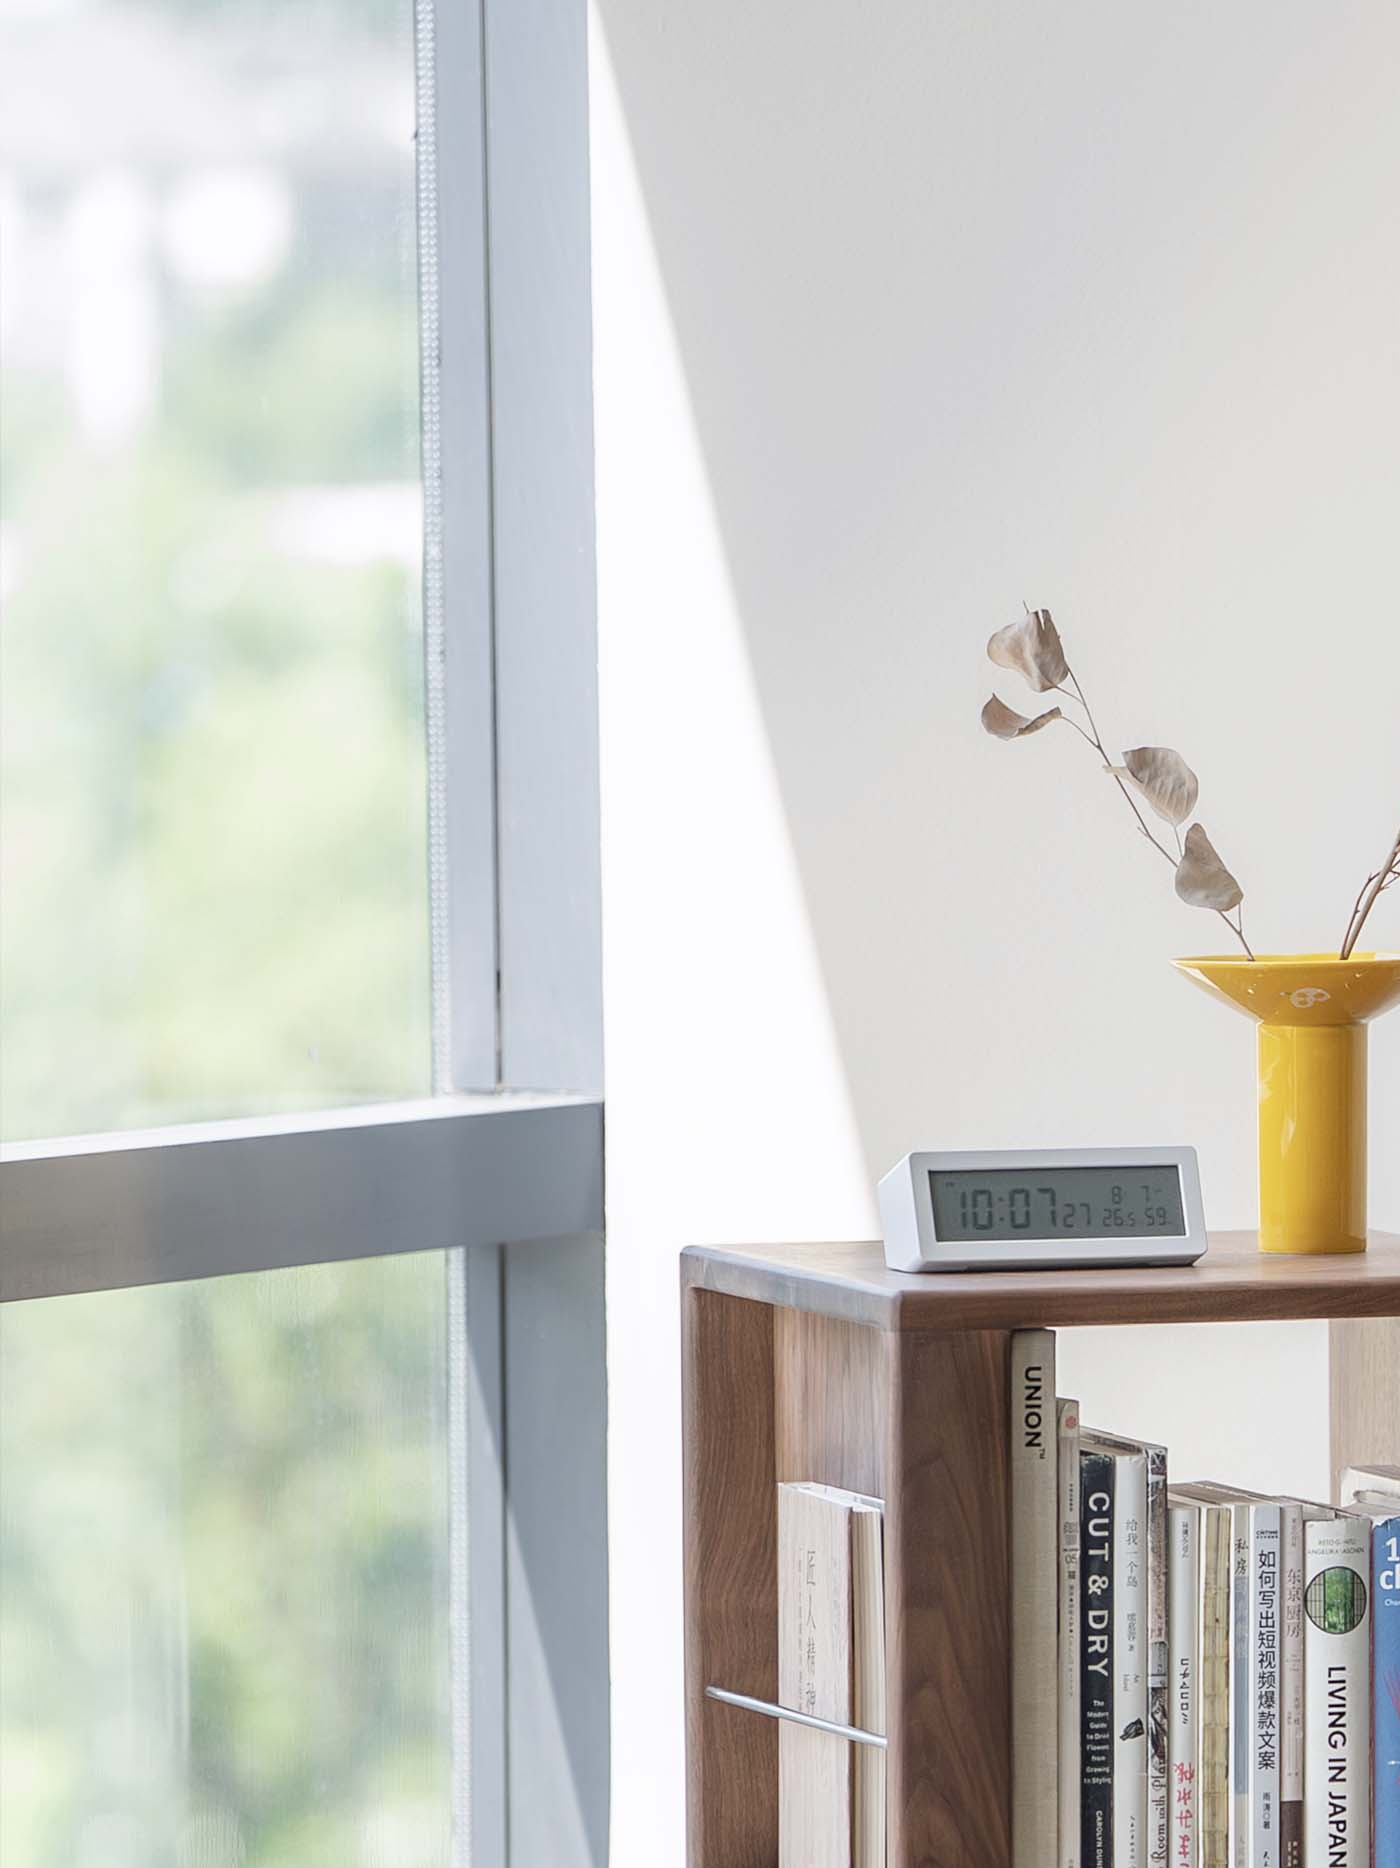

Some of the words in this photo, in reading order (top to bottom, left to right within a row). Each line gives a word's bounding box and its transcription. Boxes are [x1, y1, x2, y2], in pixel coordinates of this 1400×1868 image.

[961, 1187, 1057, 1230] 10:07
[1062, 1202, 1091, 1228] 27
[1024, 1366, 1042, 1448] UNION
[1088, 1491, 1110, 1562] CUT
[1087, 1574, 1109, 1595] &
[1087, 1609, 1109, 1677] DRY
[1257, 1549, 1276, 1770] 如何写出短视频爆款文案
[1328, 1666, 1346, 1749] LIVING
[1328, 1758, 1347, 1782] IN
[1151, 1795, 1166, 1819] with
[1328, 1792, 1347, 1868] JAPAN
[1150, 1823, 1166, 1863] Room
